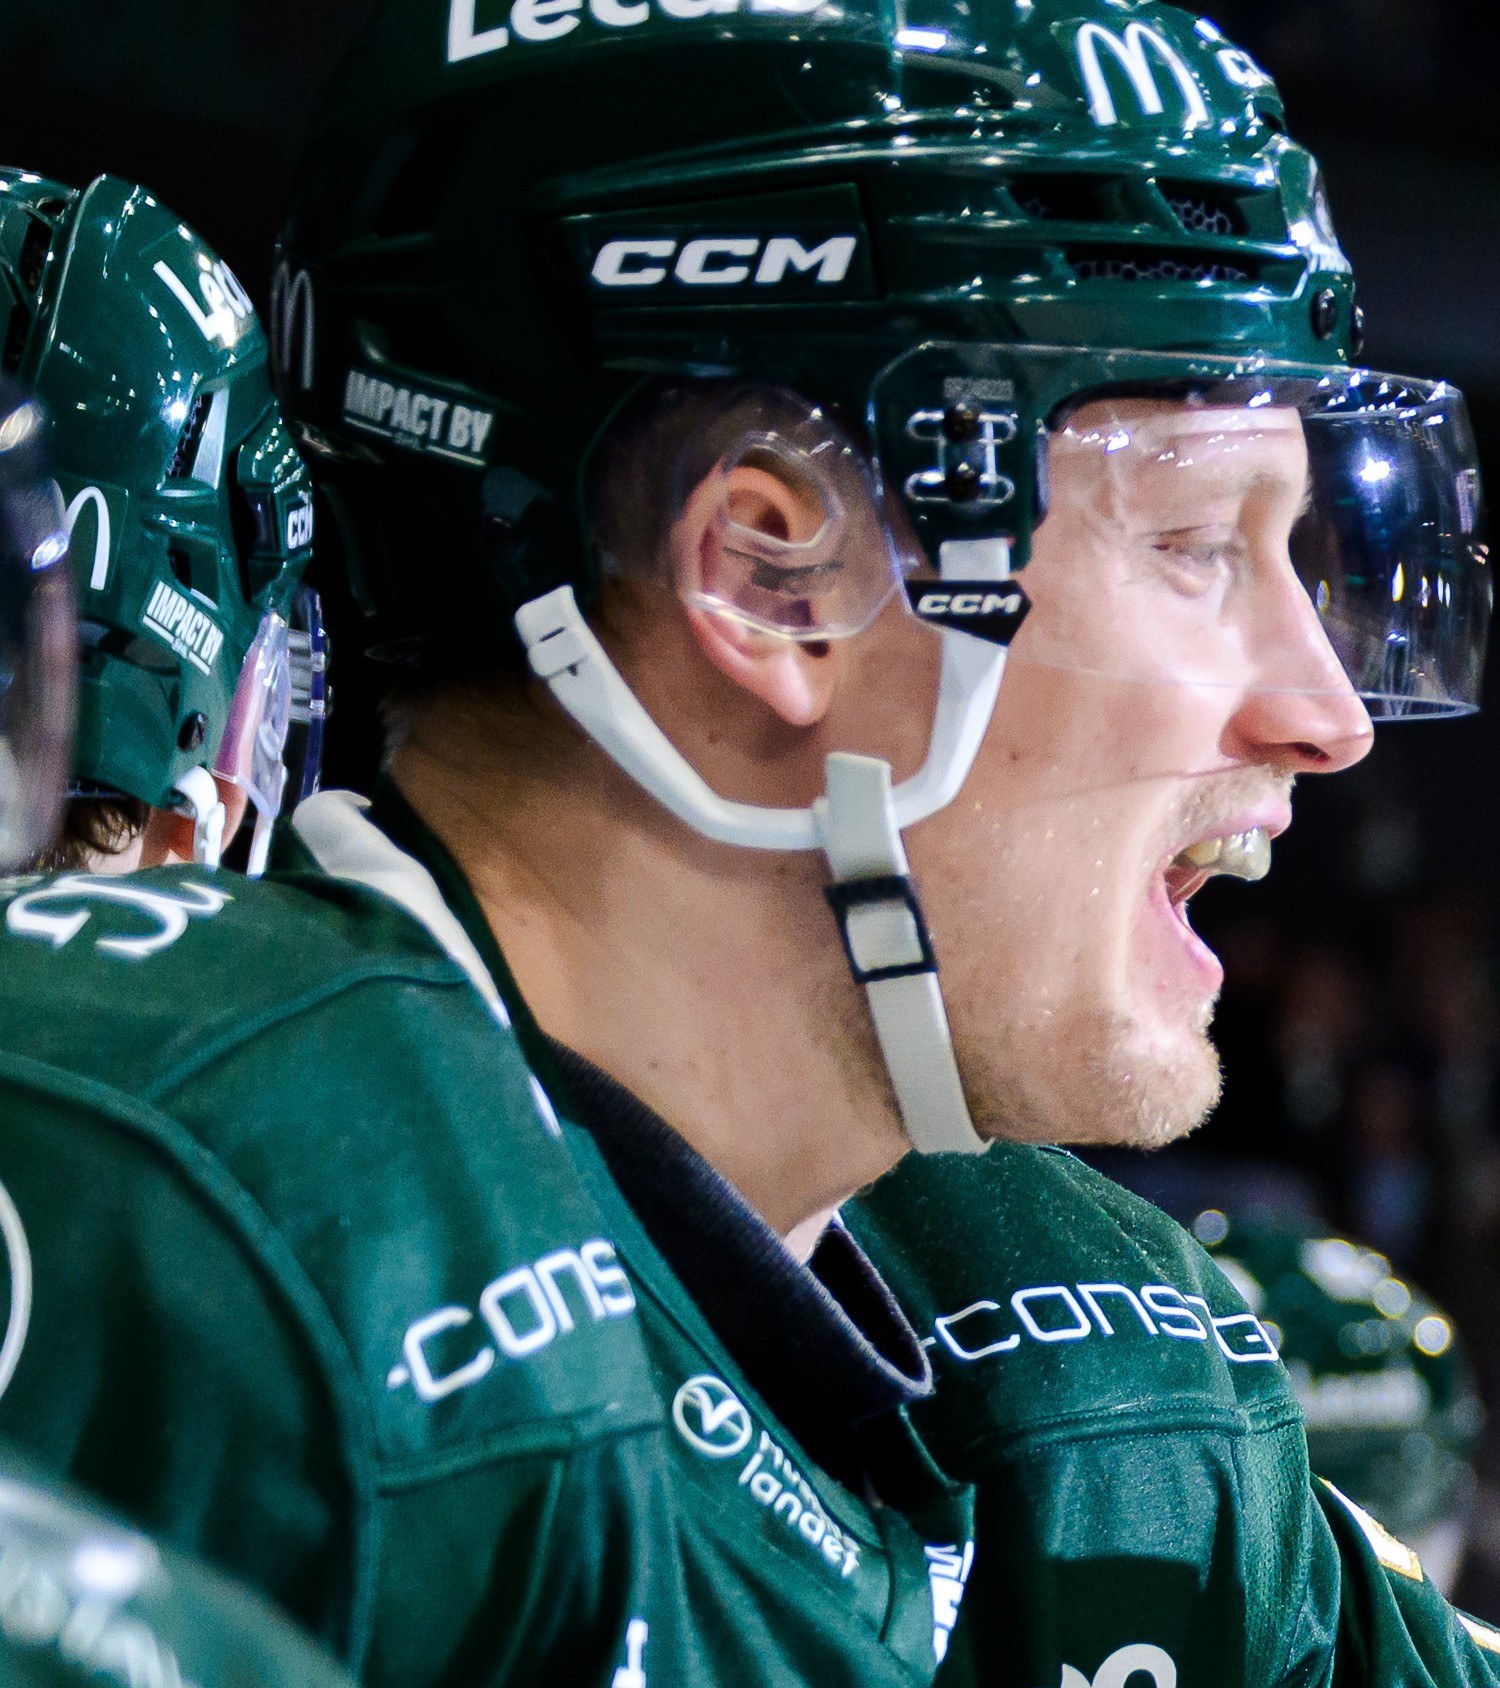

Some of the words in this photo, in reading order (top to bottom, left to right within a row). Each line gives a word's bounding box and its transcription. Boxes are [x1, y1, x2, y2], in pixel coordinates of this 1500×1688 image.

[591, 237, 857, 286] CCM
[344, 370, 448, 440] IMPACT
[448, 405, 493, 452] BY
[146, 580, 211, 651] IMPACT
[917, 594, 1021, 614] CCM
